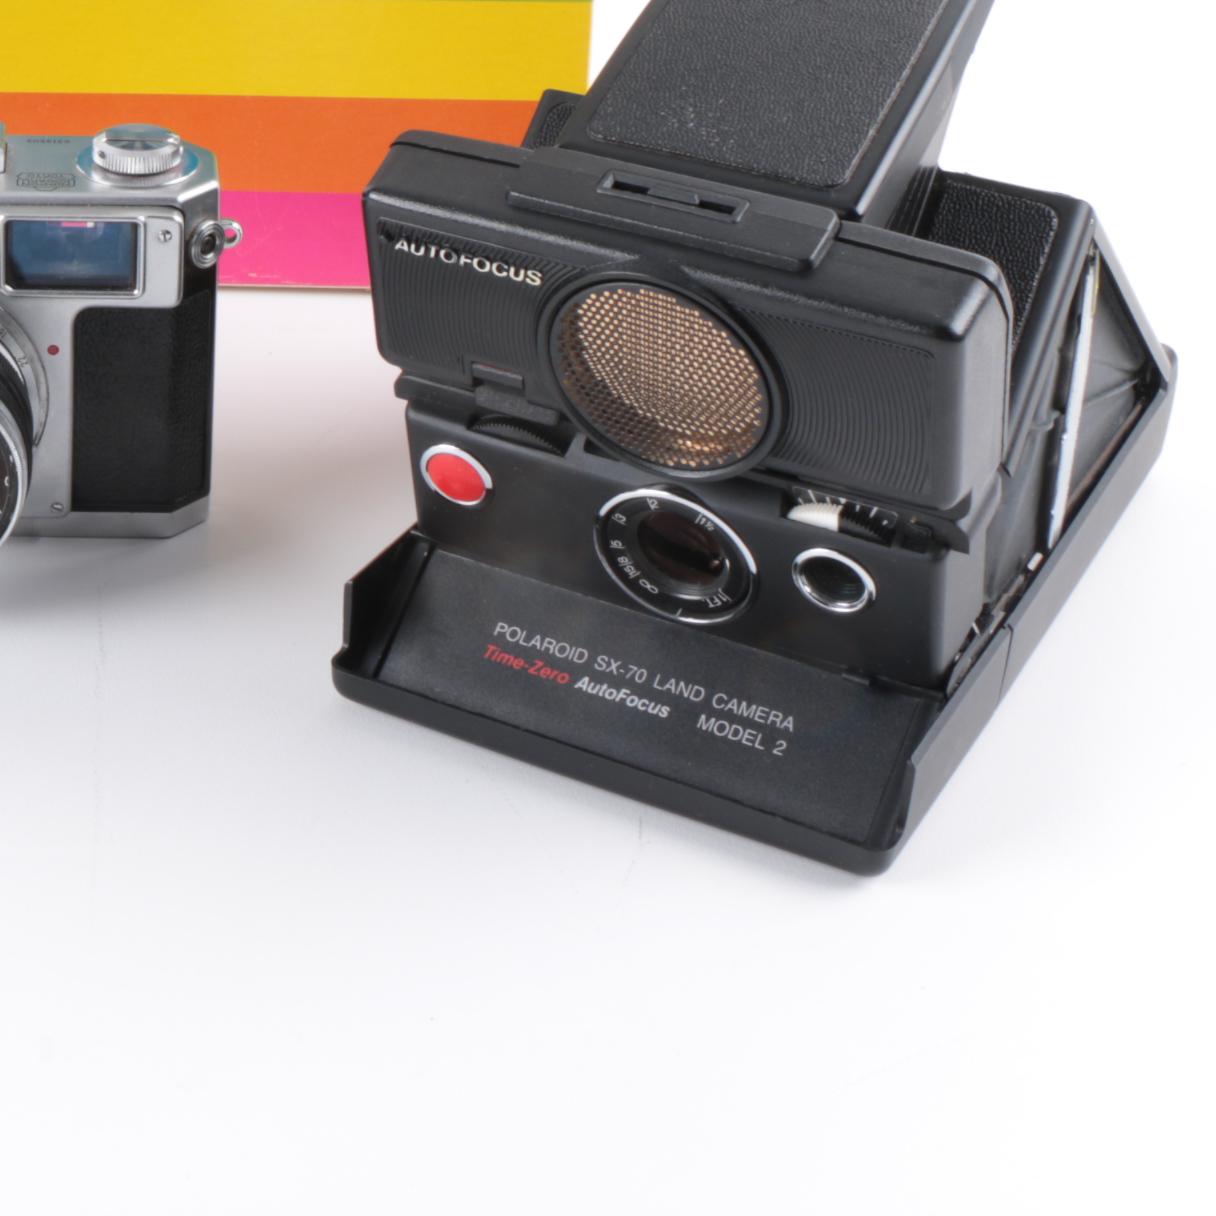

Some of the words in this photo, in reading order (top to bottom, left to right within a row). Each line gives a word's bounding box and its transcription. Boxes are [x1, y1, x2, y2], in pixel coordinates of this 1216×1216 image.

[394, 239, 544, 286] AUTOFOCUS
[483, 644, 570, 684] Time-Zero
[574, 676, 671, 718] AutoFocus
[696, 714, 765, 750] MODEL
[772, 740, 787, 755] 2
[493, 622, 588, 664] POLAROID
[594, 655, 648, 683] SX-70
[653, 674, 705, 702] LAND
[712, 692, 794, 732] CAMERA
